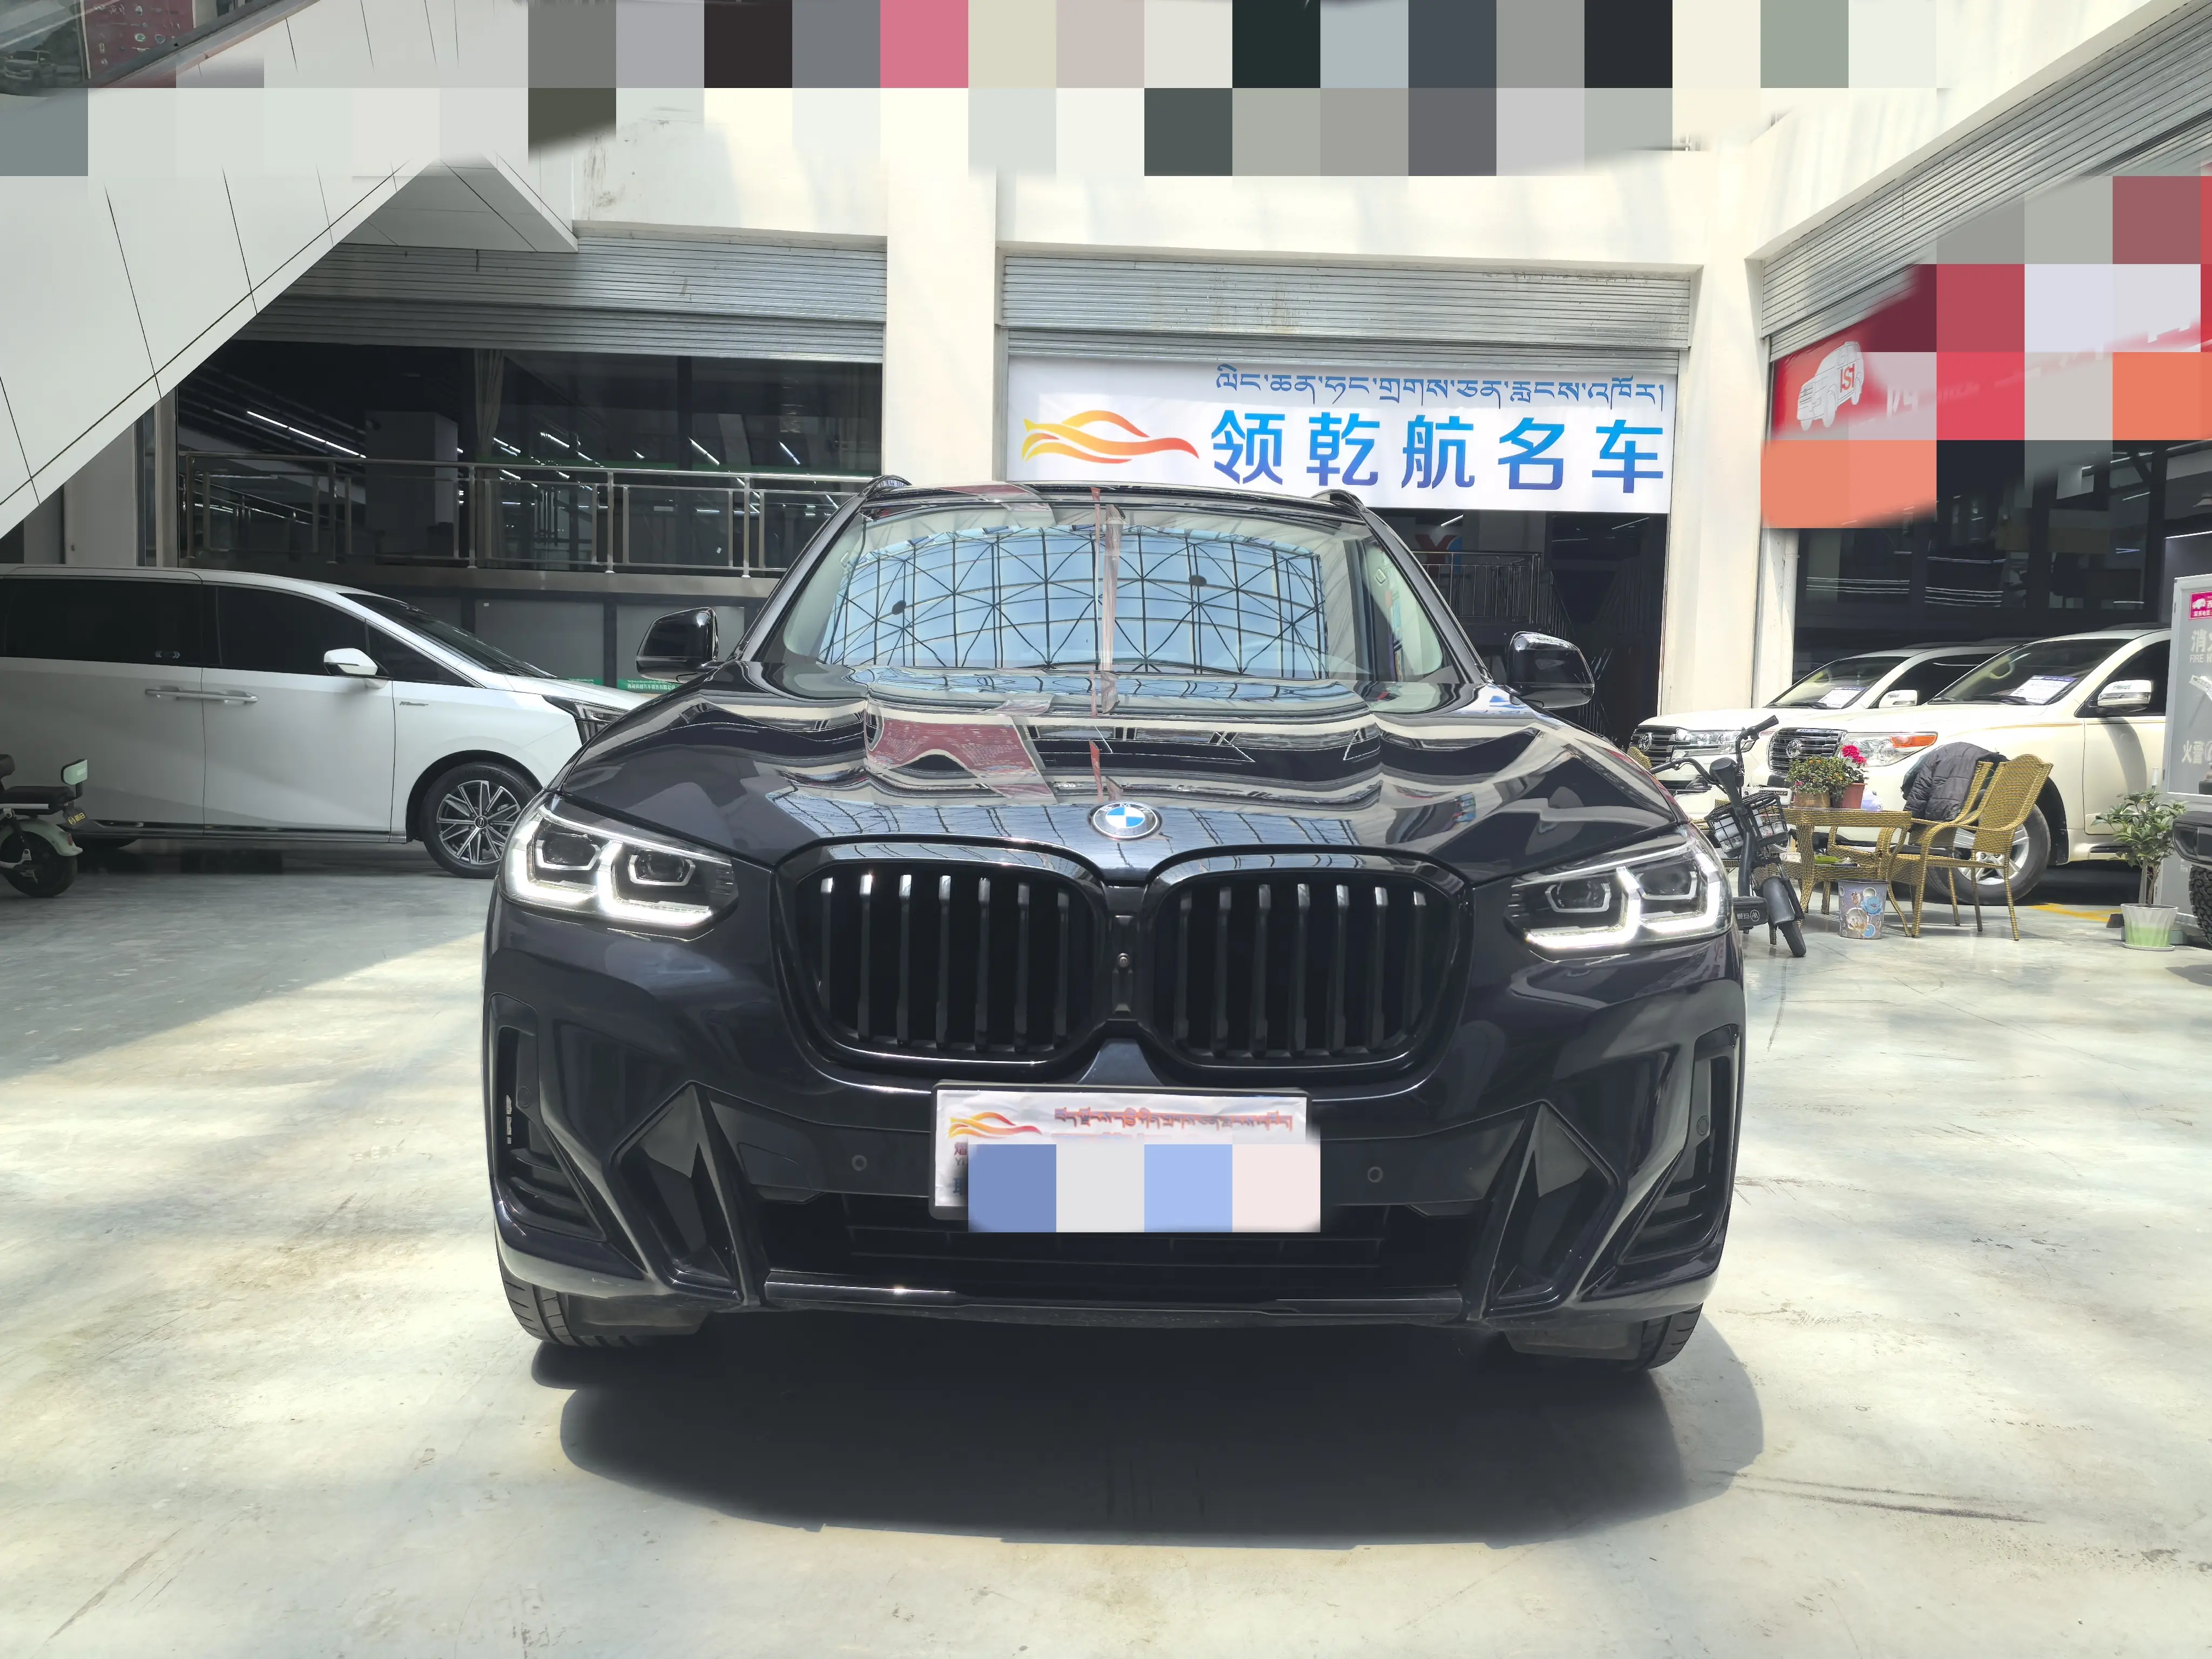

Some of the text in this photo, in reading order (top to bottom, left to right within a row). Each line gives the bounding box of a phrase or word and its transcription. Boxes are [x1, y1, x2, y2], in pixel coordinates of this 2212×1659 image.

[1211, 409, 1664, 494] 领乾航名车
[2190, 653, 2203, 663] FIRE
[2182, 740, 2204, 765] 火警
